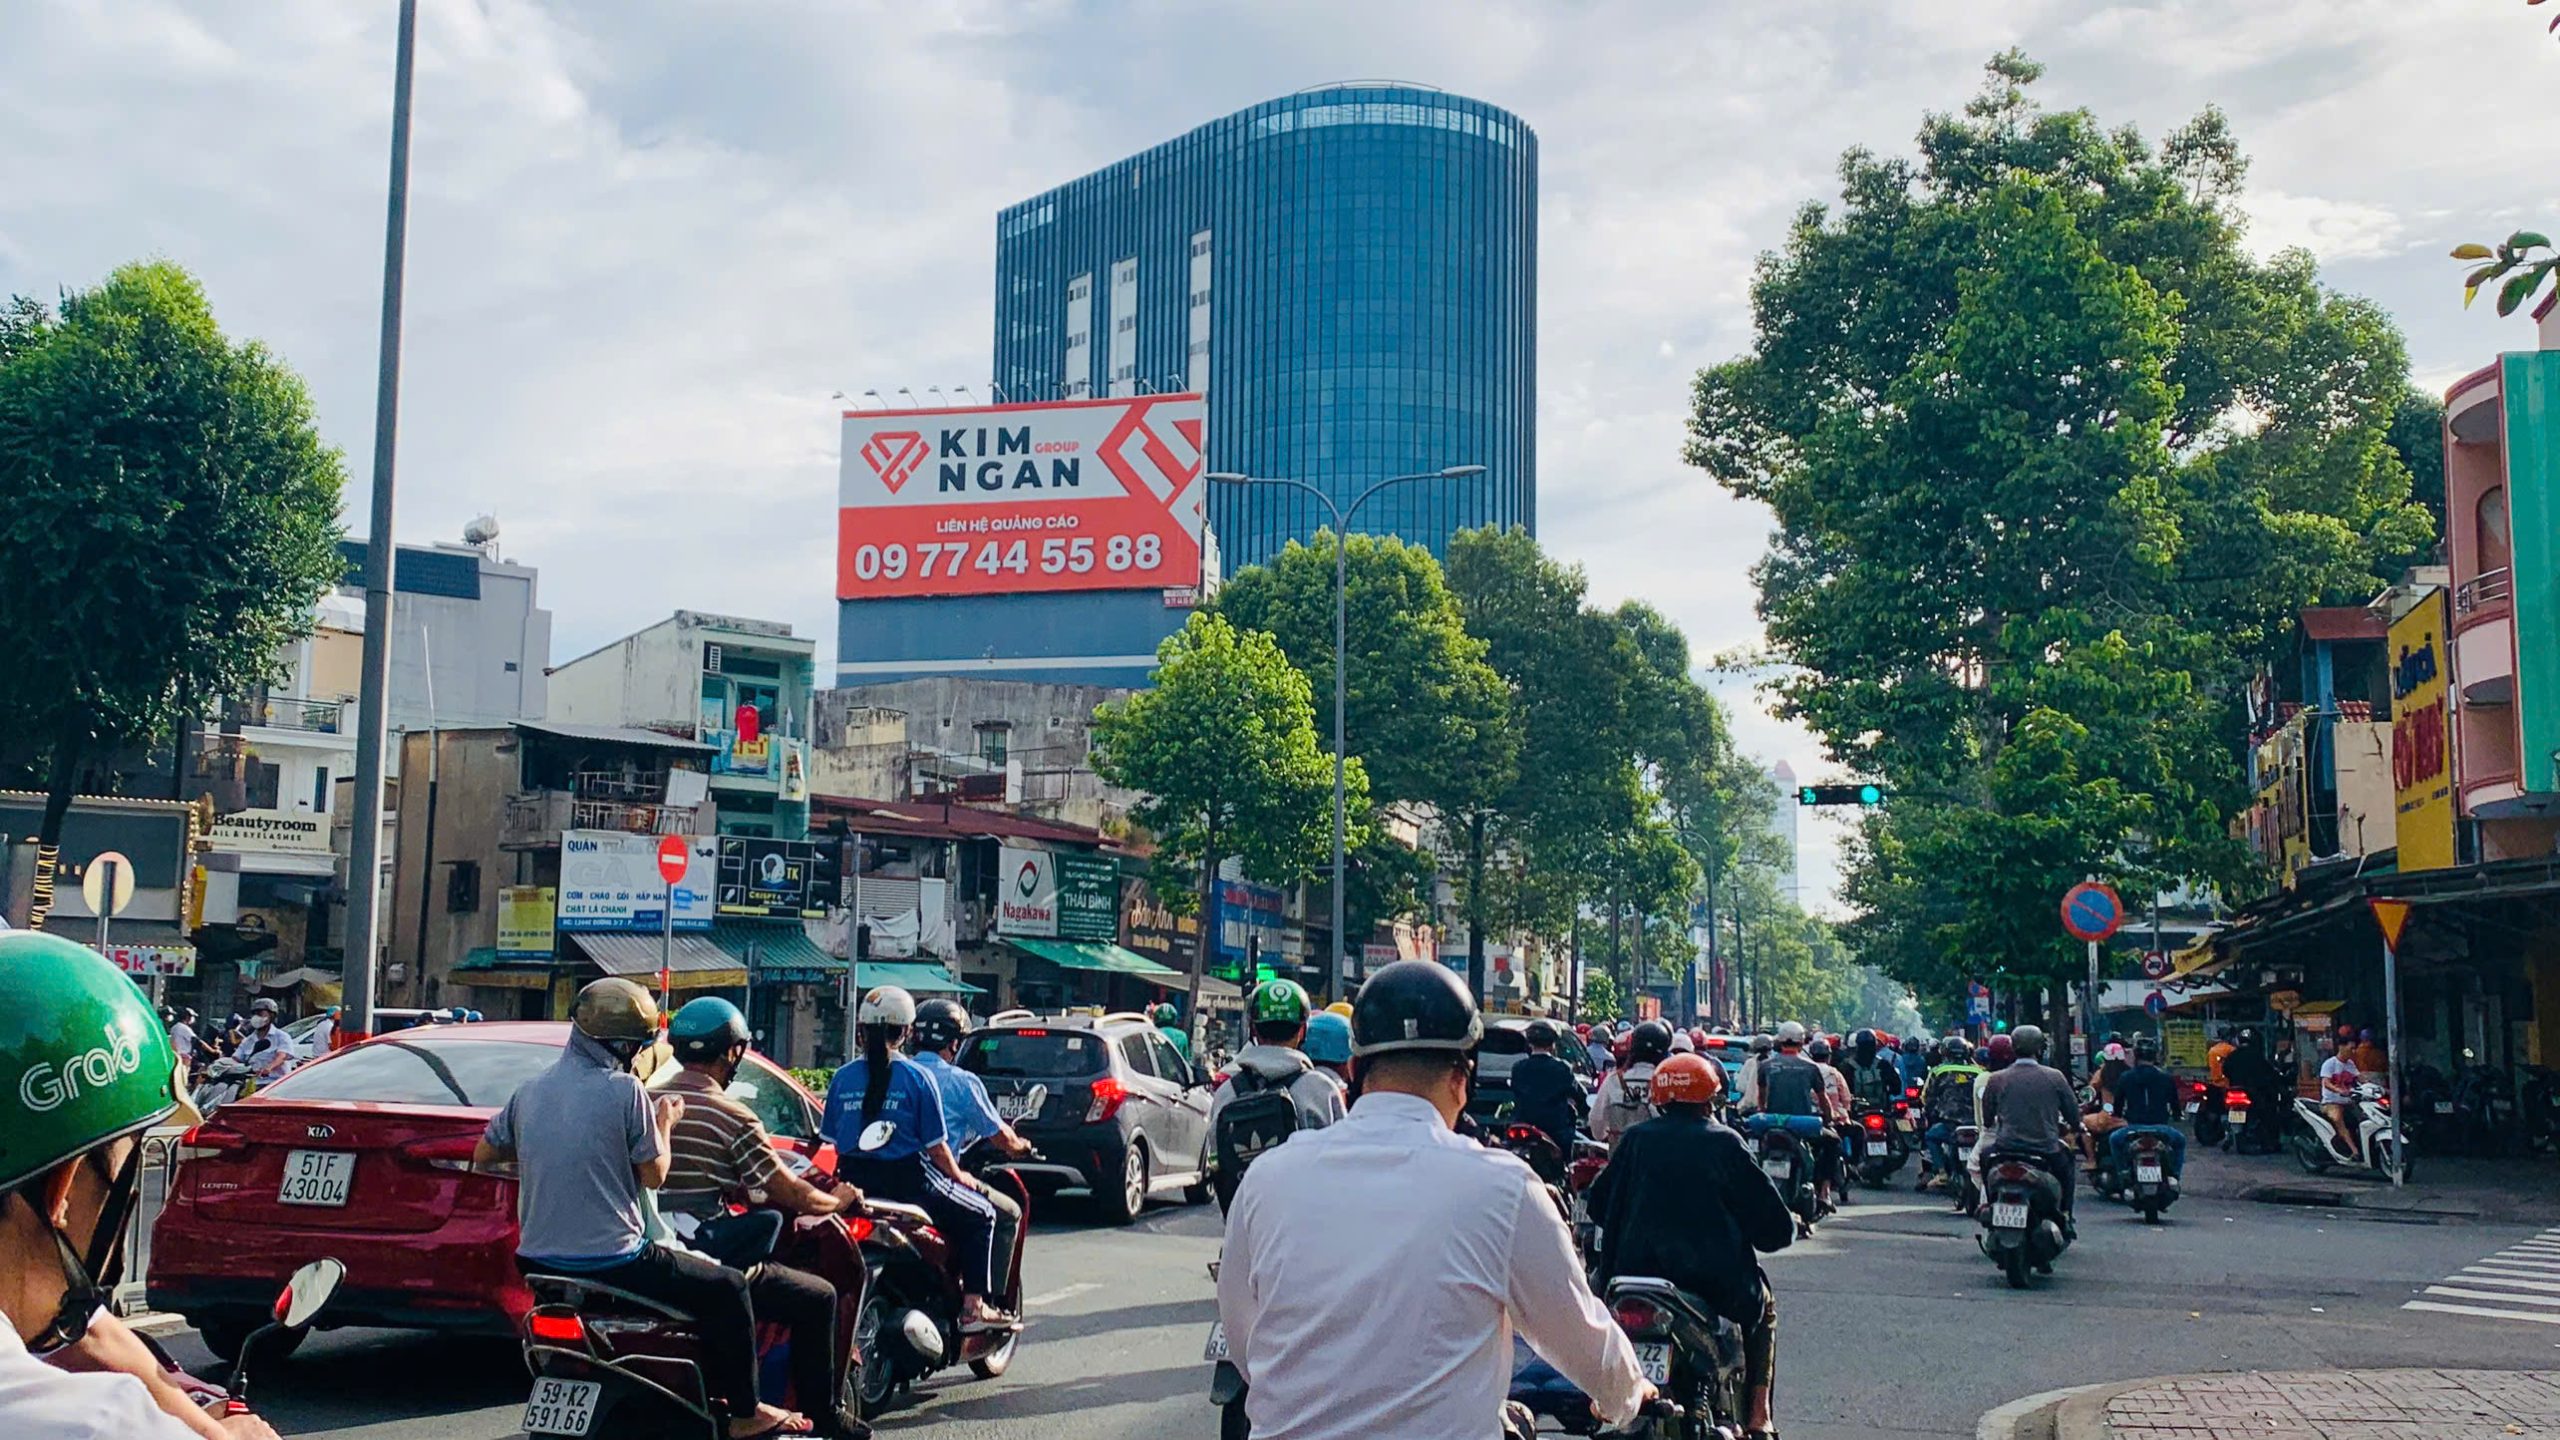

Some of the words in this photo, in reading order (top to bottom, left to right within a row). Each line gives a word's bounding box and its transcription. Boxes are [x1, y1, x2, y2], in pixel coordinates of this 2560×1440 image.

[940, 426, 1030, 458] KIM
[1034, 441, 1080, 454] GROUP
[939, 458, 1080, 492] NGAN
[936, 518, 967, 533] LIÊN
[969, 516, 989, 534] HỆ
[991, 514, 1043, 531] QUẢNG
[1045, 513, 1080, 528] CÁO
[1040, 537, 1095, 574] 55
[1105, 533, 1162, 571] 88
[212, 829, 230, 837] AIL
[213, 812, 317, 832] Beautyroom
[567, 838, 598, 850] QUÁN
[1003, 901, 1051, 921] Nagakawa
[20, 1023, 140, 1111] Grab
[307, 1126, 329, 1138] KIA
[301, 1154, 338, 1177] 51F
[282, 1177, 344, 1202] 430.04
[541, 1381, 590, 1407] 59-K2
[527, 1405, 588, 1432] 591.66
